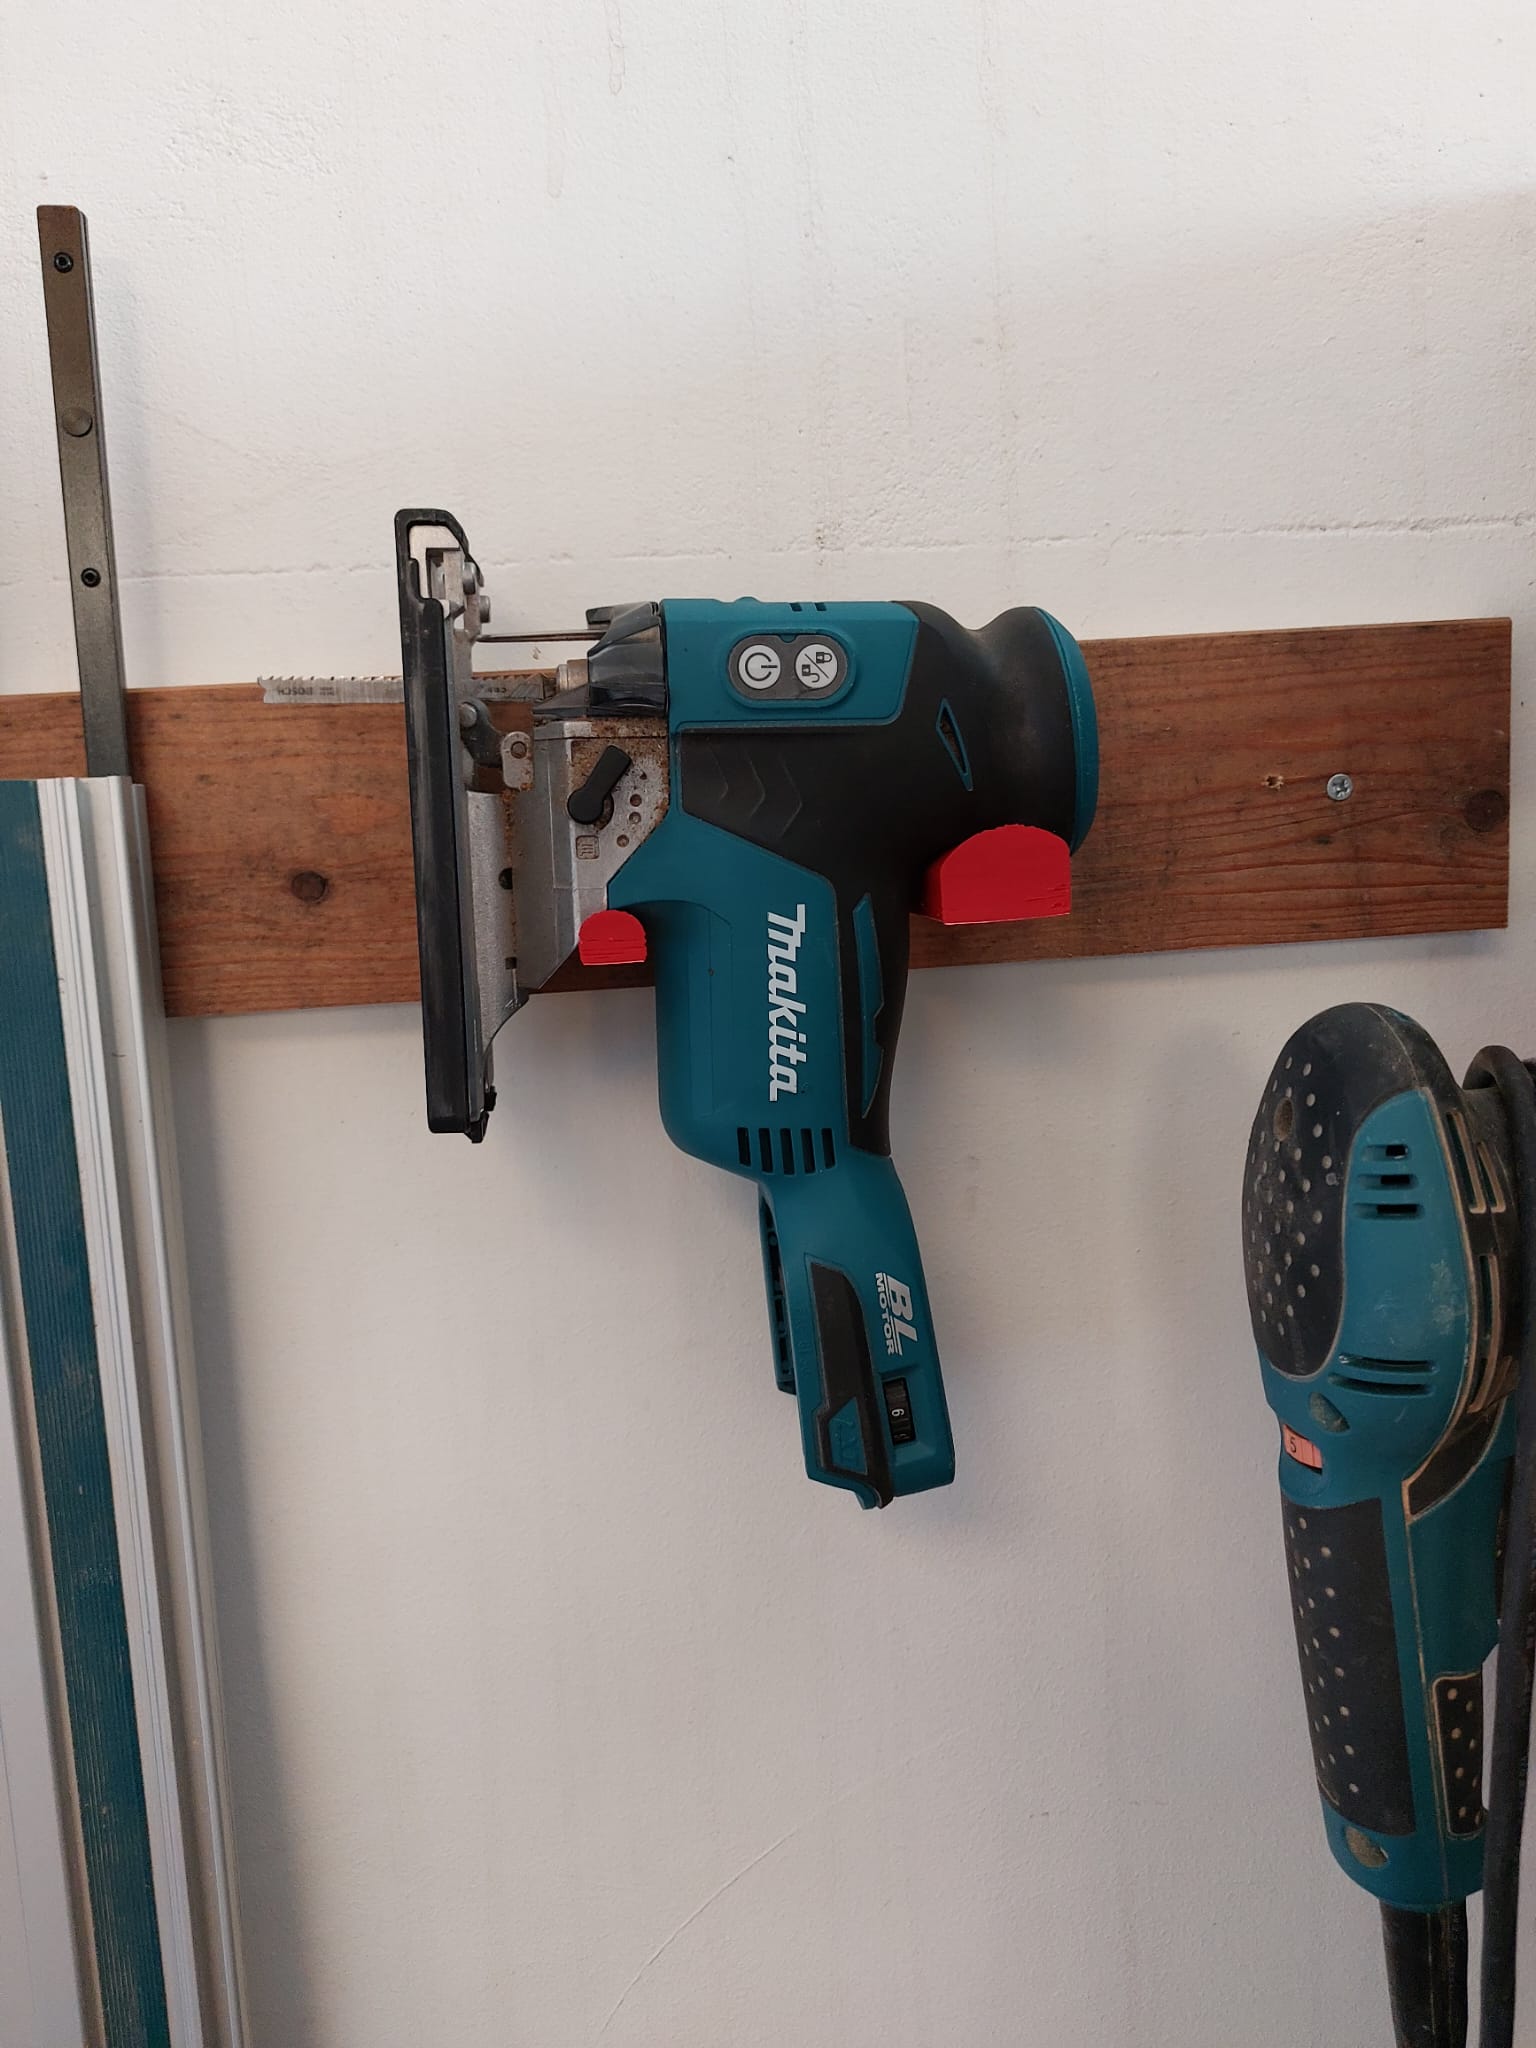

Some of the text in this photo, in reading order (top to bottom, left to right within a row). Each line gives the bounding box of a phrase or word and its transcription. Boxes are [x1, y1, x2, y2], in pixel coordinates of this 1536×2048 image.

[767, 904, 807, 1101] Makita
[875, 1272, 894, 1355] MOTOR
[887, 1275, 918, 1356] BL
[891, 1408, 904, 1417] 6
